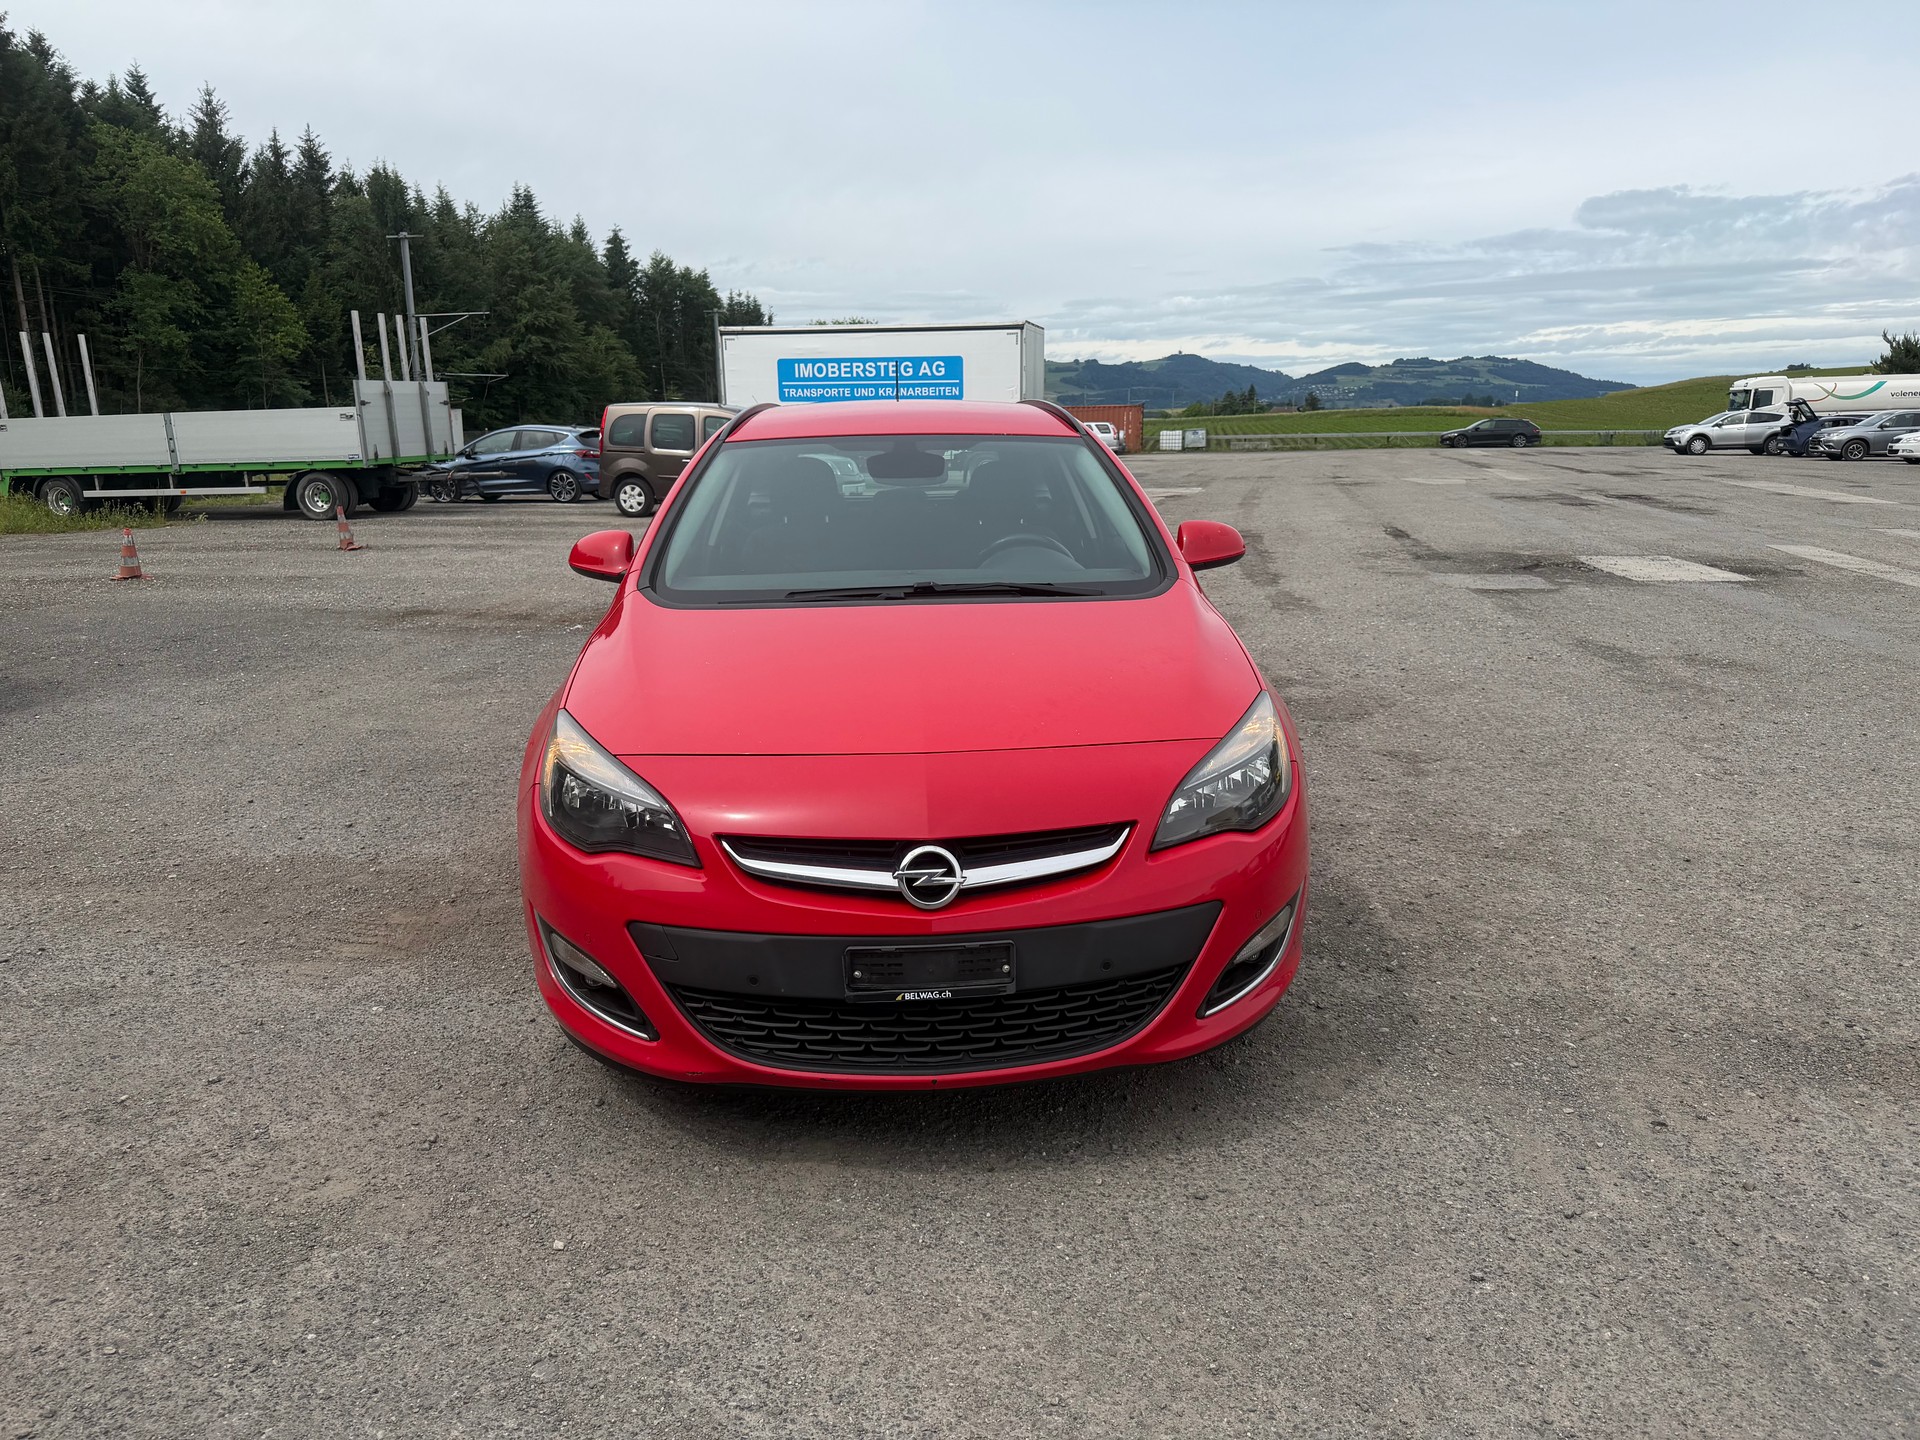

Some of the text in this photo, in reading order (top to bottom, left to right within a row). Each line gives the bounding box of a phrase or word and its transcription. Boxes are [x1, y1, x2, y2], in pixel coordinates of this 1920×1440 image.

[794, 361, 945, 378] IMOBERSTEG AG
[783, 387, 851, 397] TRANSPORTE
[854, 387, 875, 397] UND
[904, 990, 952, 1000] BELWAG.ch
